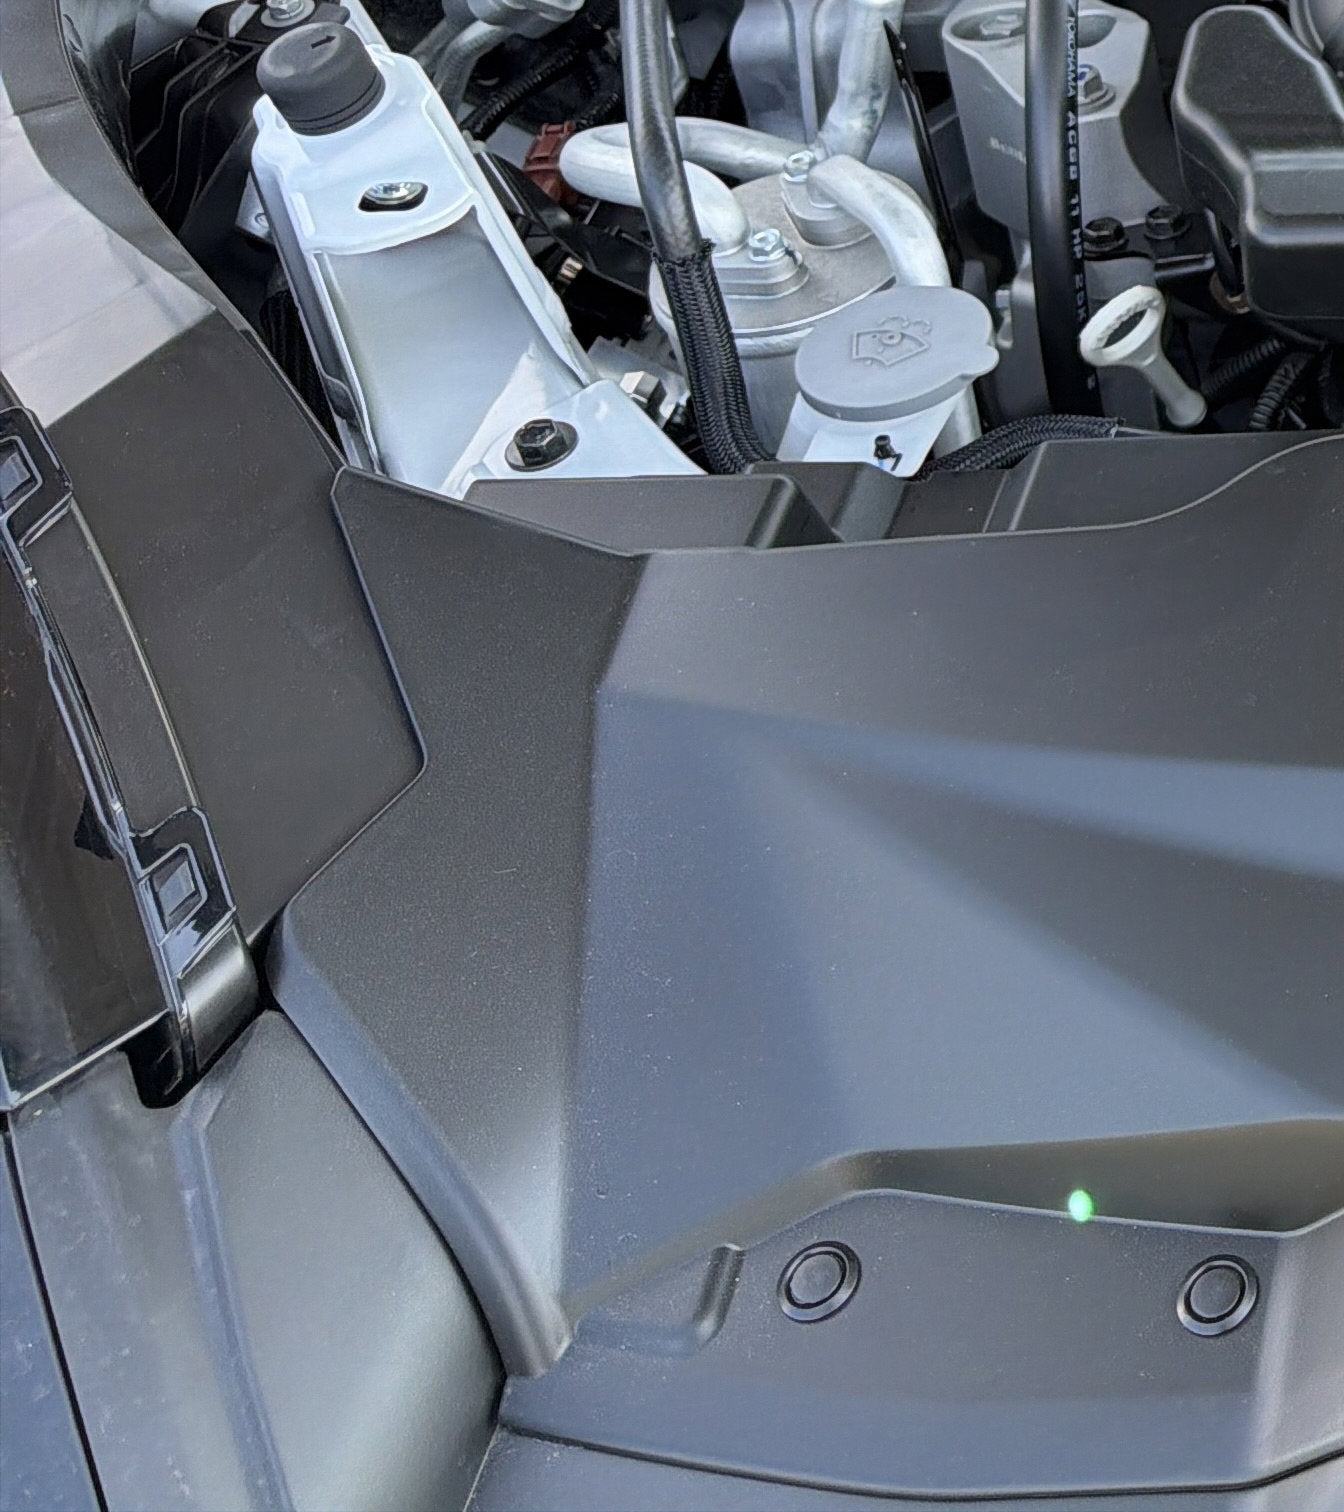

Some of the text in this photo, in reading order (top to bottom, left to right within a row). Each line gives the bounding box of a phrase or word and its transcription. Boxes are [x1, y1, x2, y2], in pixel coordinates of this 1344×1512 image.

[1067, 16, 1077, 98] YOKOHAMA
[1069, 194, 1079, 216] 11
[1072, 229, 1082, 259] HP
